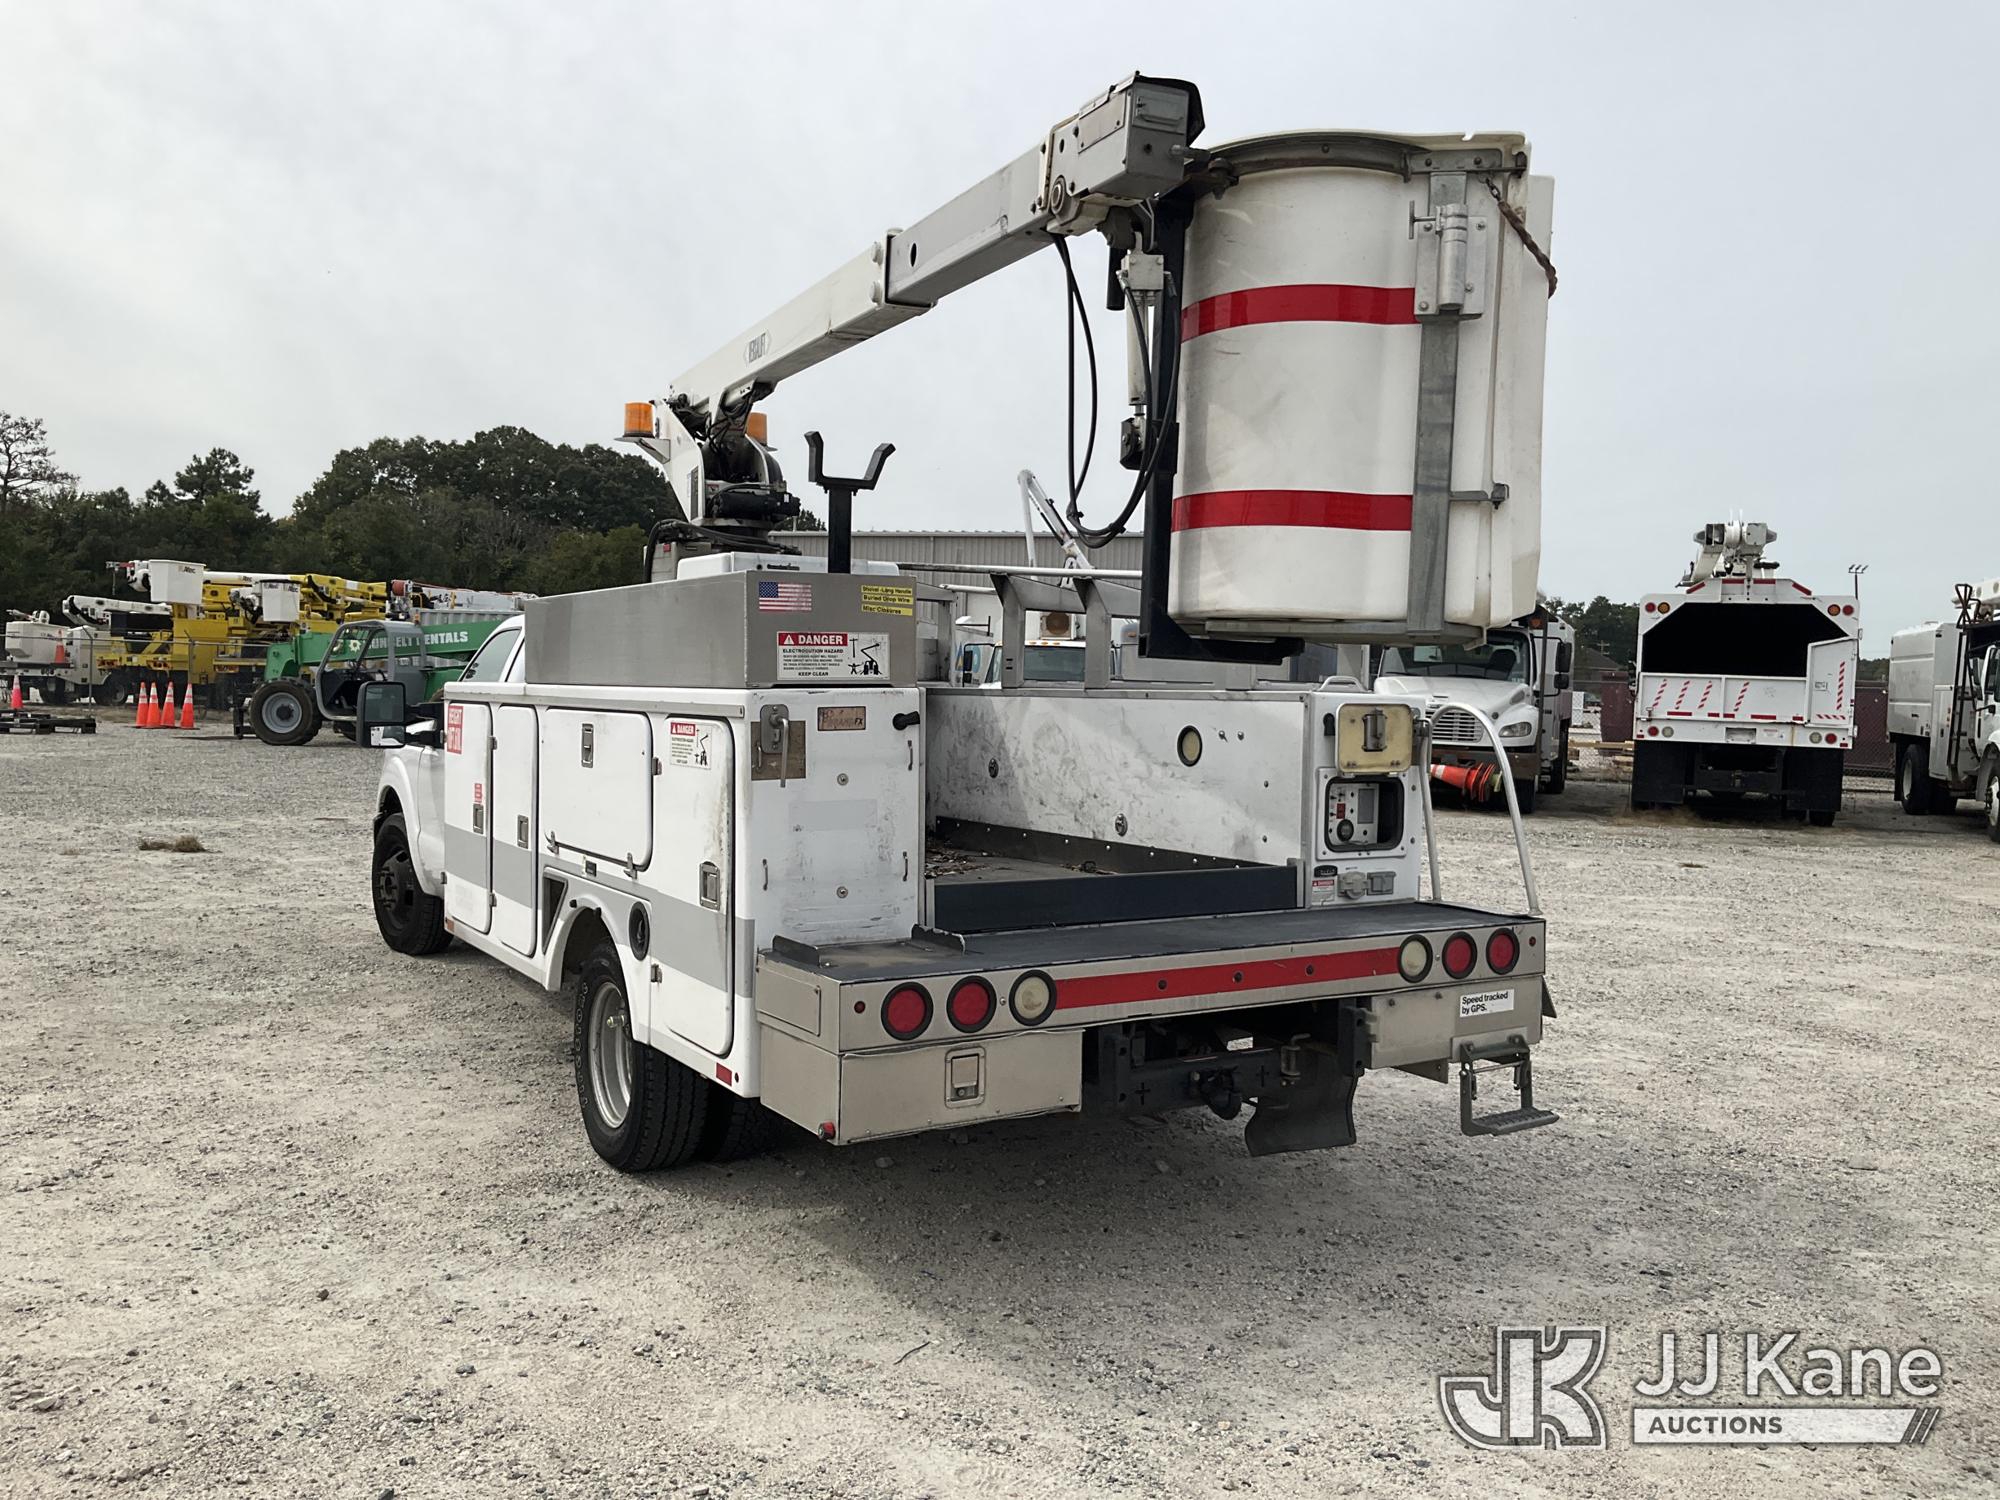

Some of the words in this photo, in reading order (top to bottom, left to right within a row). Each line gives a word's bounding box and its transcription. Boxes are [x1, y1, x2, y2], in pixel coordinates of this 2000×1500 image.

[877, 606, 901, 614] Closures
[798, 634, 843, 645] DANGER
[677, 724, 694, 734] DANGER
[1462, 995, 1483, 1005] Speed
[1484, 991, 1508, 1001] tracked
[1461, 1006, 1470, 1015] by
[1471, 1003, 1487, 1013] GPS.
